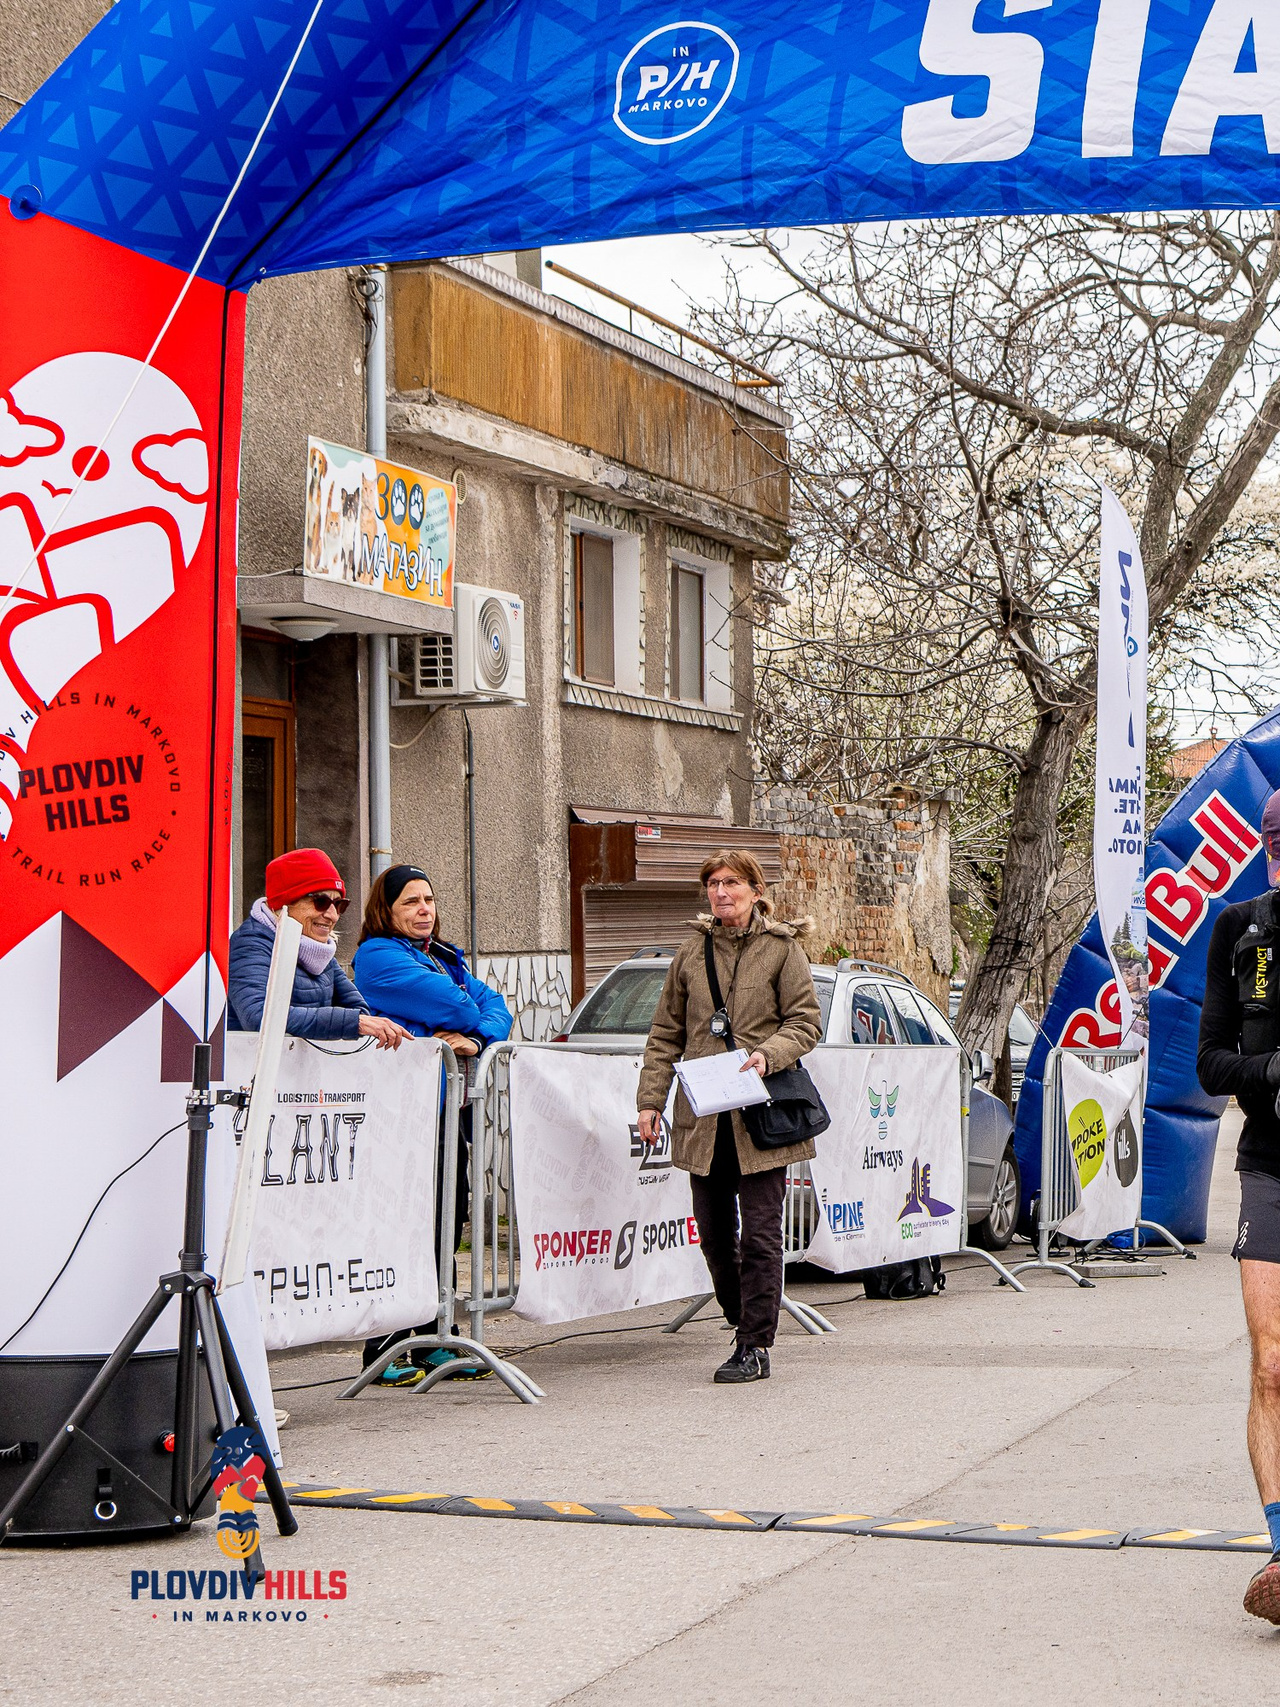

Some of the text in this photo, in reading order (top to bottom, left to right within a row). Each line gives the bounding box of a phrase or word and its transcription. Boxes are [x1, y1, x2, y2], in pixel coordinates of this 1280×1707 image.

[672, 46, 690, 57] IN
[637, 60, 720, 101] P/H
[628, 97, 708, 113] MARKOVO
[360, 533, 444, 597] МАГАЗИН
[20, 692, 81, 725] HILLS
[95, 692, 116, 709] IN
[126, 704, 181, 793] MARKOVO
[18, 754, 144, 800] PLOVDIV
[44, 794, 131, 832] HILLS
[12, 828, 171, 887] TRAIL RUN RACE
[1145, 792, 1262, 943] Bull
[862, 1146, 904, 1172] Airways
[534, 1229, 612, 1271] SPONSER
